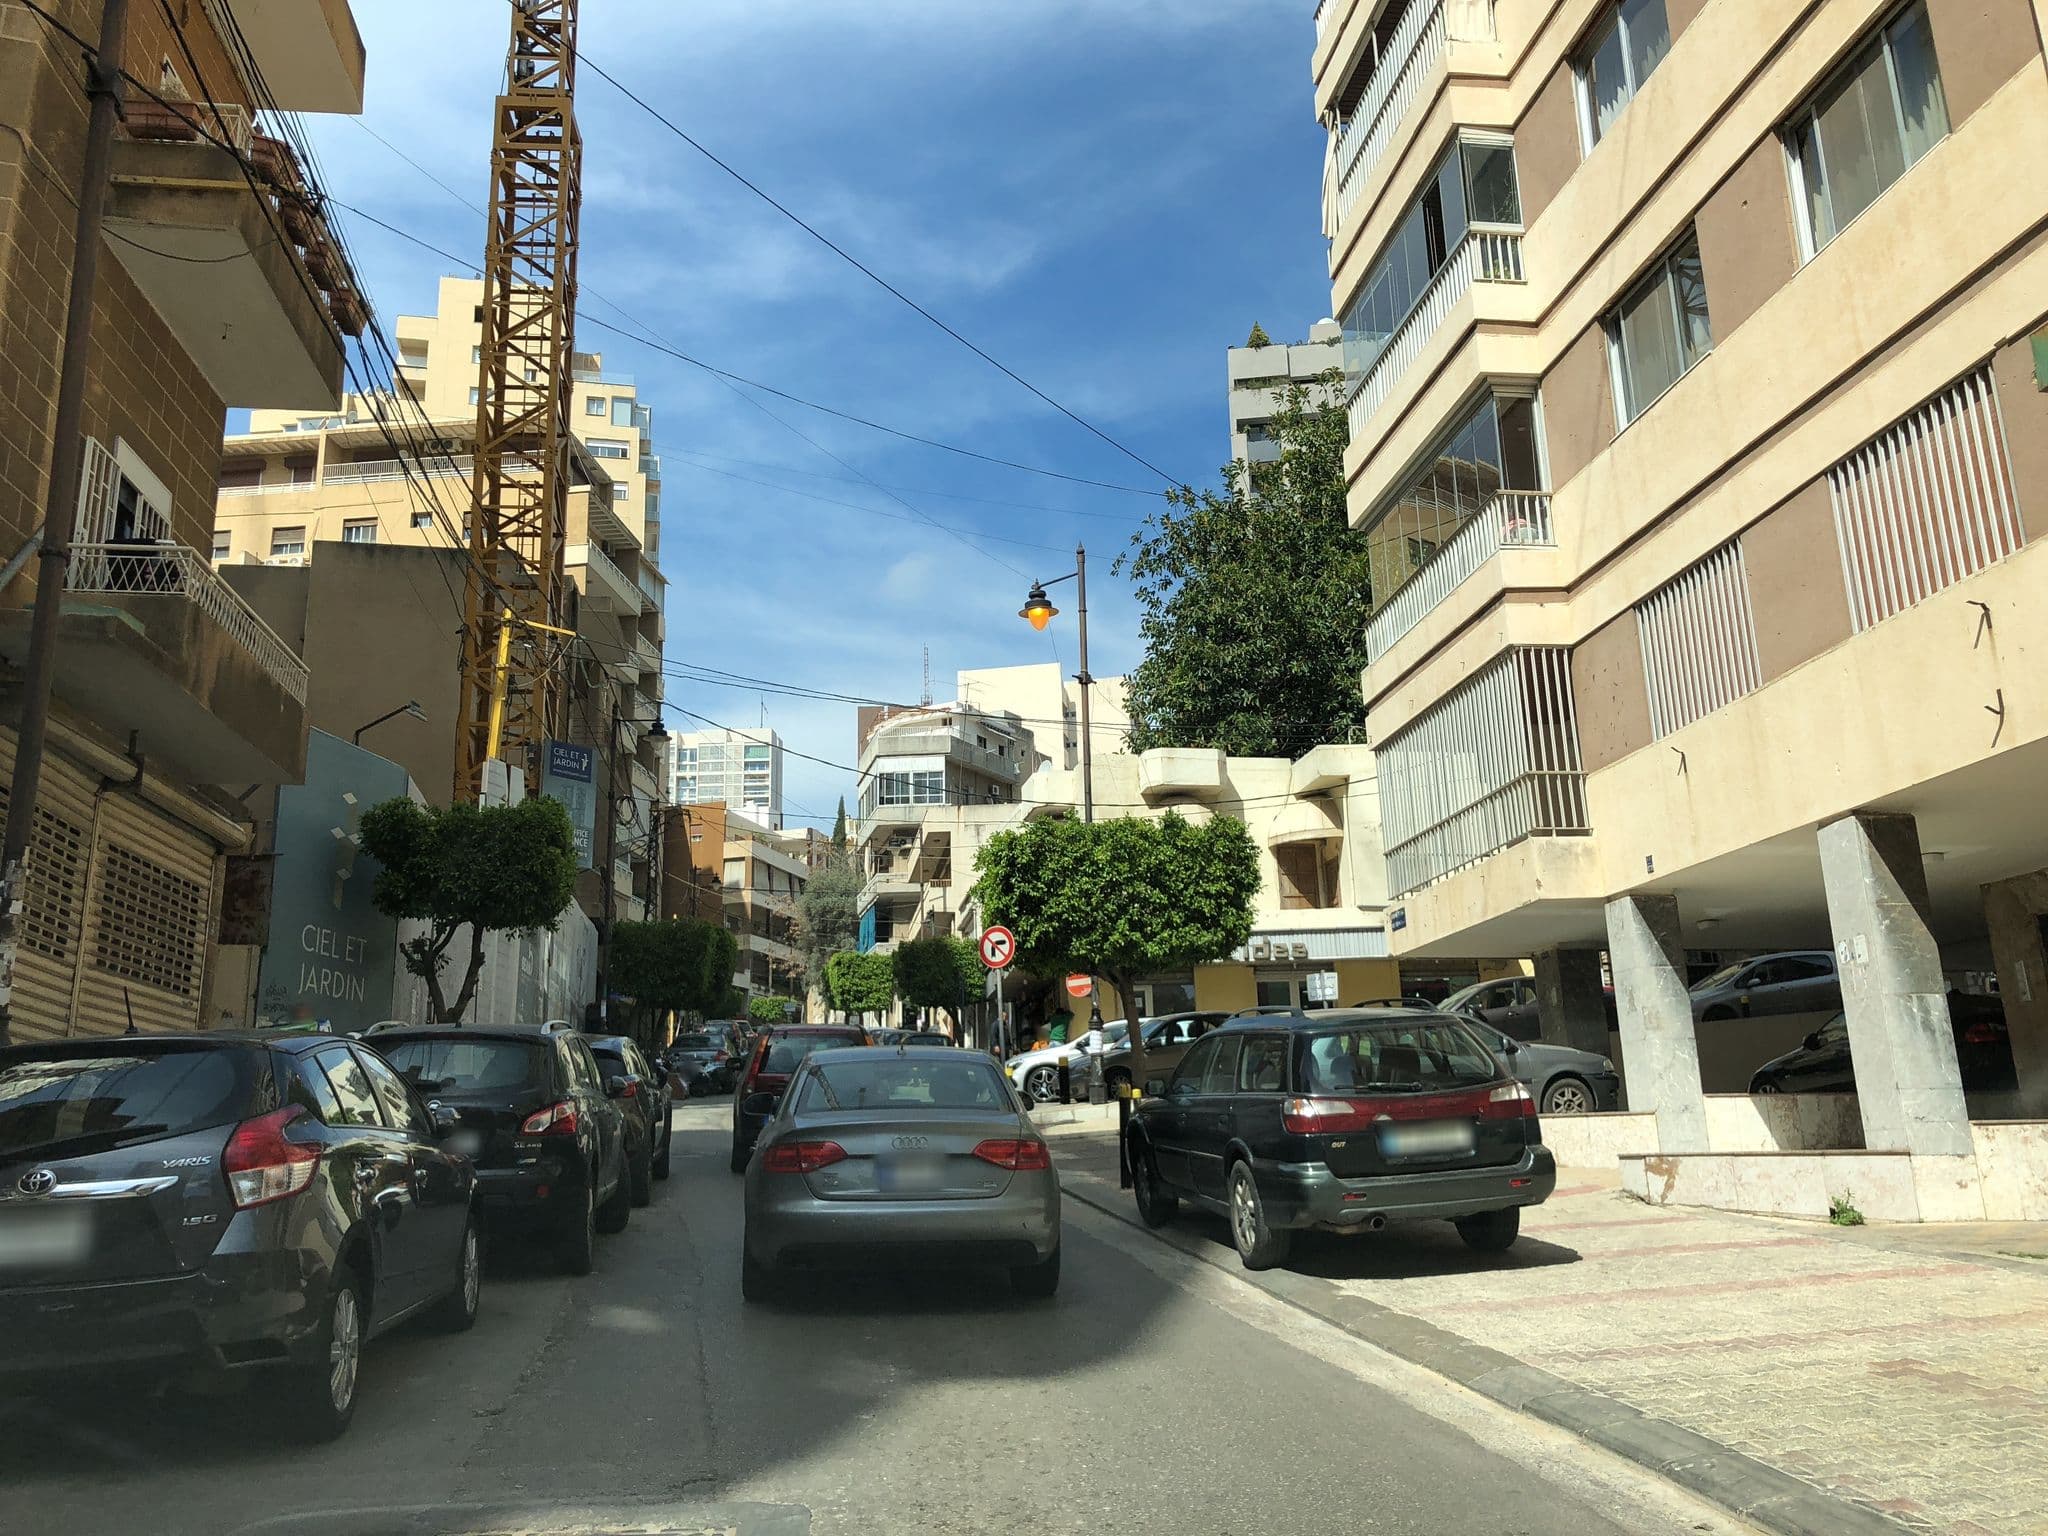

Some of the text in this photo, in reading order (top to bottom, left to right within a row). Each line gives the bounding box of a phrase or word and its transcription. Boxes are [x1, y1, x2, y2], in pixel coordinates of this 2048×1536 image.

[553, 747, 580, 760] CIEL ET
[553, 757, 580, 769] JARDIN
[302, 924, 368, 965] CIEL ET
[298, 962, 366, 1003] JARDIN
[162, 1155, 213, 1169] YARIS
